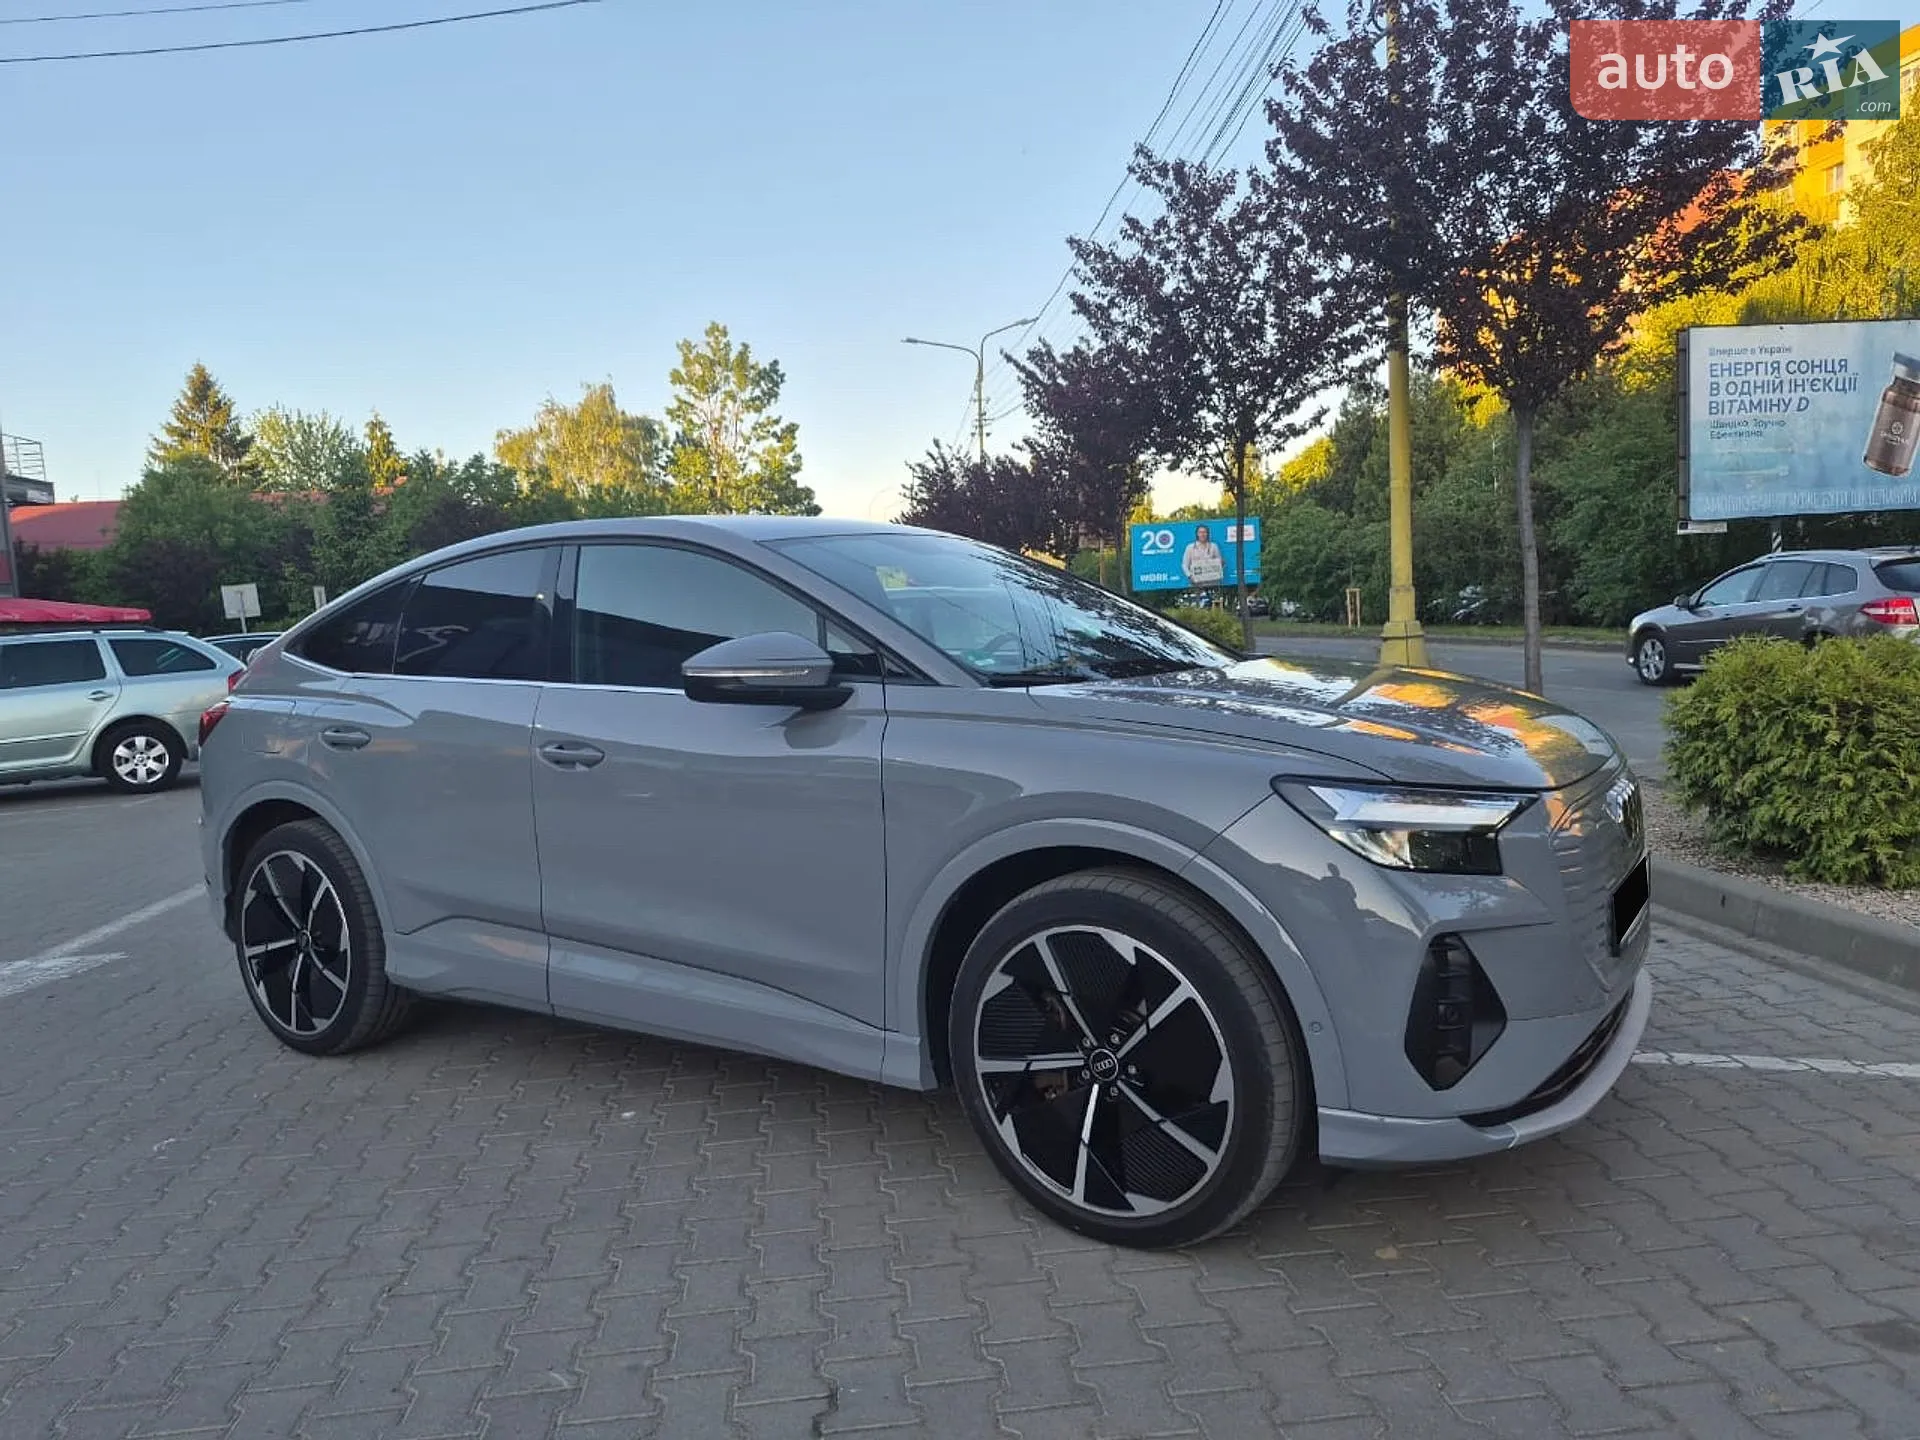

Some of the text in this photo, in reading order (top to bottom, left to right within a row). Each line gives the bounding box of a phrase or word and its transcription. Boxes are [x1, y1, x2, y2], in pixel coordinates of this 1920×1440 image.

[1709, 359, 1848, 378] ЕНЕРГІЯ СОНЦЯ
[1709, 381, 1720, 397] В
[1725, 376, 1784, 398] ОДНІЙ
[1708, 396, 1810, 416] ВІТАМІНУ D
[1141, 530, 1174, 555] 20
